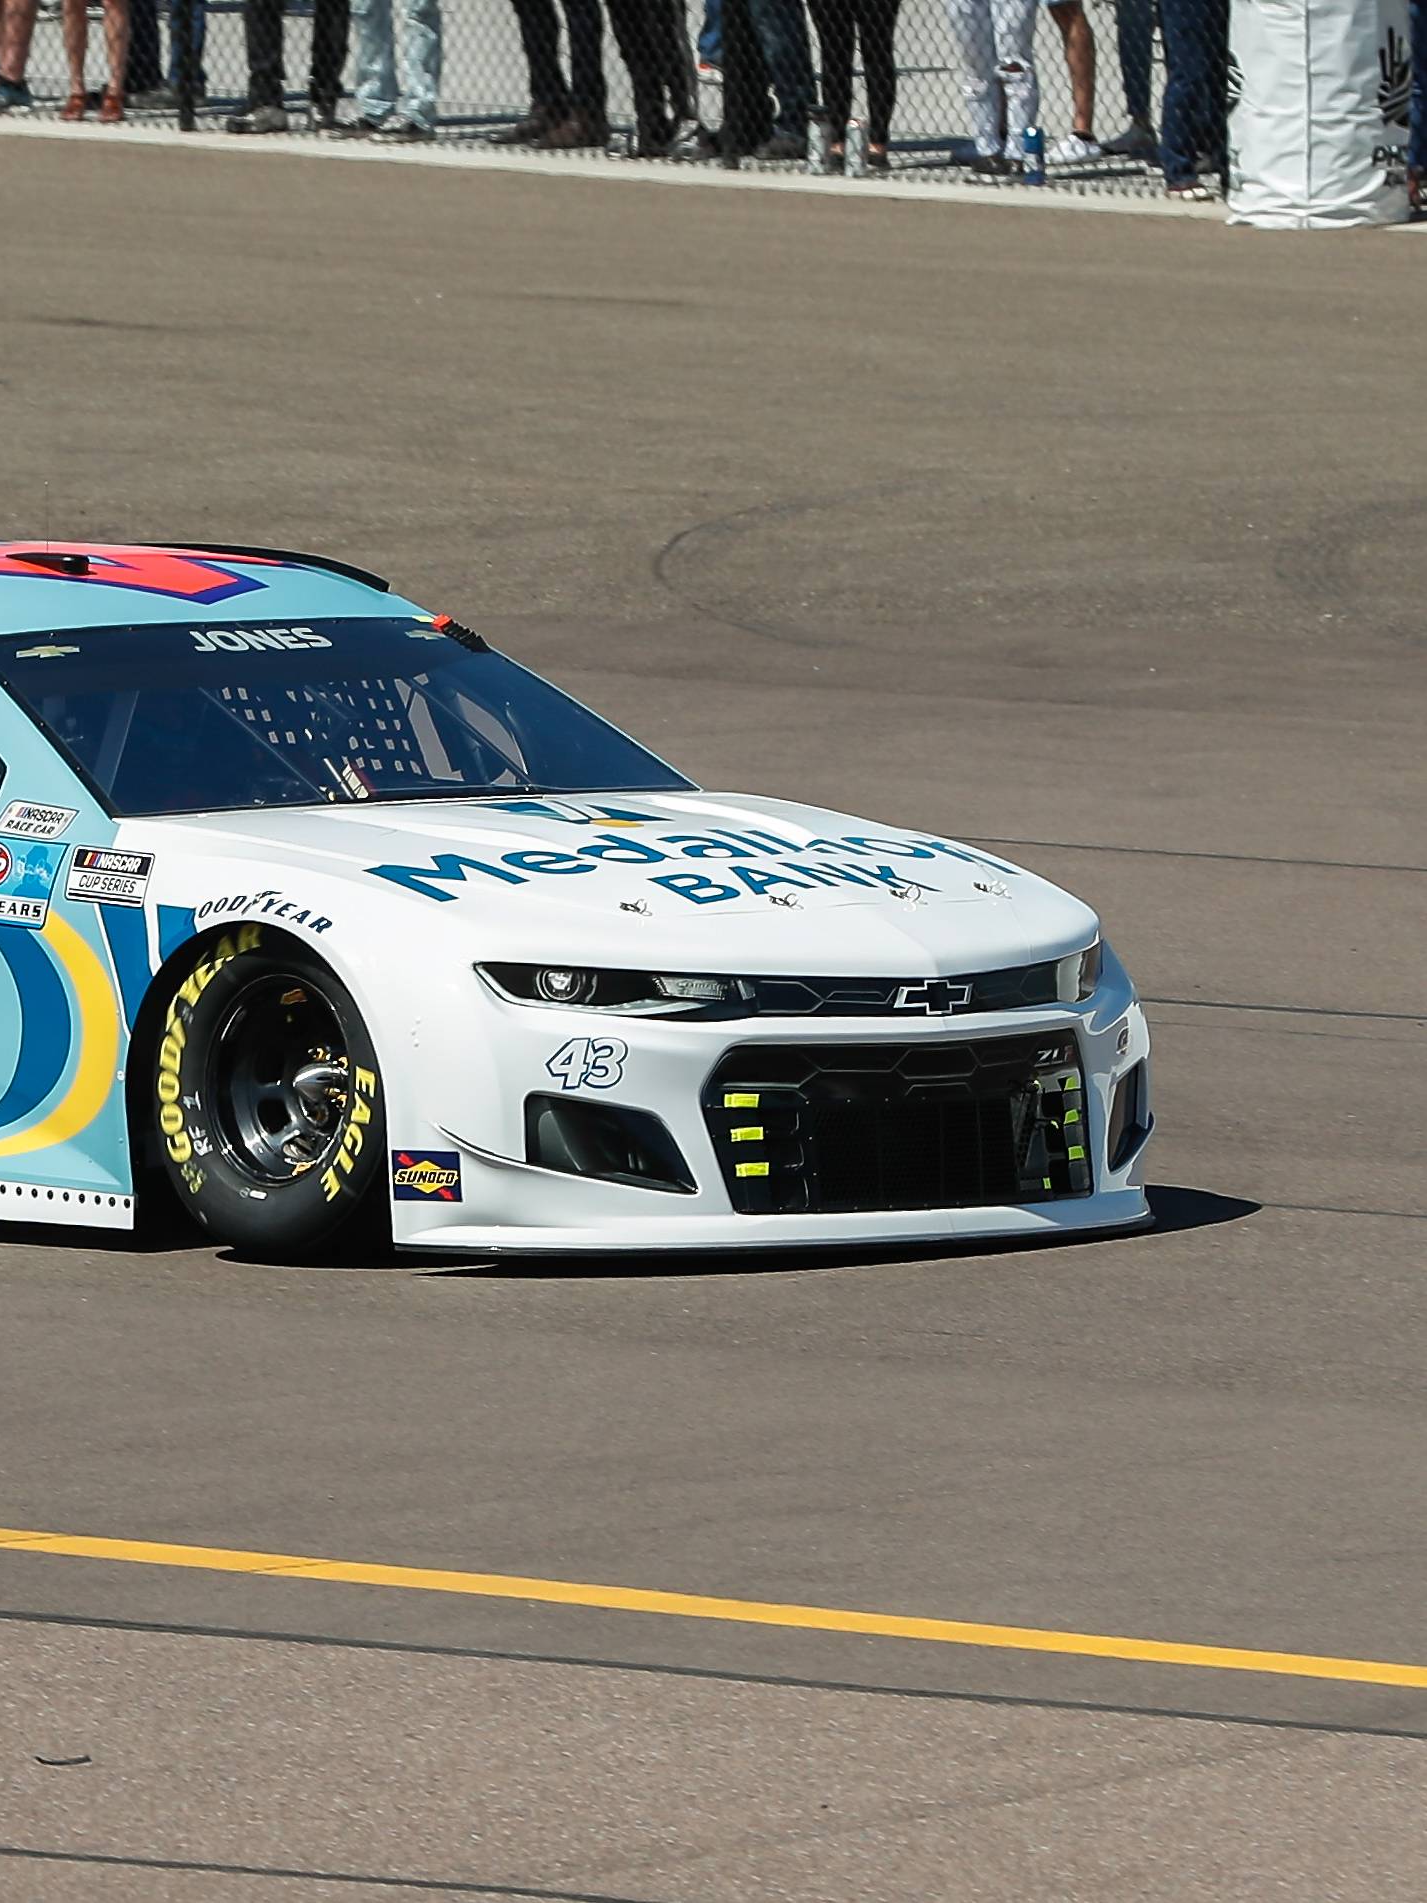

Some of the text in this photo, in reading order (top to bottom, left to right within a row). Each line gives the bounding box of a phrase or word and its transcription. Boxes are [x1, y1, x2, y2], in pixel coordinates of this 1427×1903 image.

[189, 627, 333, 652] JONES
[5, 820, 55, 835] RACE CAR
[25, 806, 64, 824] NASCAR
[96, 852, 142, 873] NASCAR
[364, 829, 1024, 902] Medallion
[78, 874, 137, 894] CUP SERIES
[646, 862, 944, 905] BANK
[157, 921, 264, 1164] GOODYEAR
[546, 1037, 628, 1090] 43
[319, 1066, 376, 1202] EAGLE
[397, 1168, 456, 1185] SUNOCO
